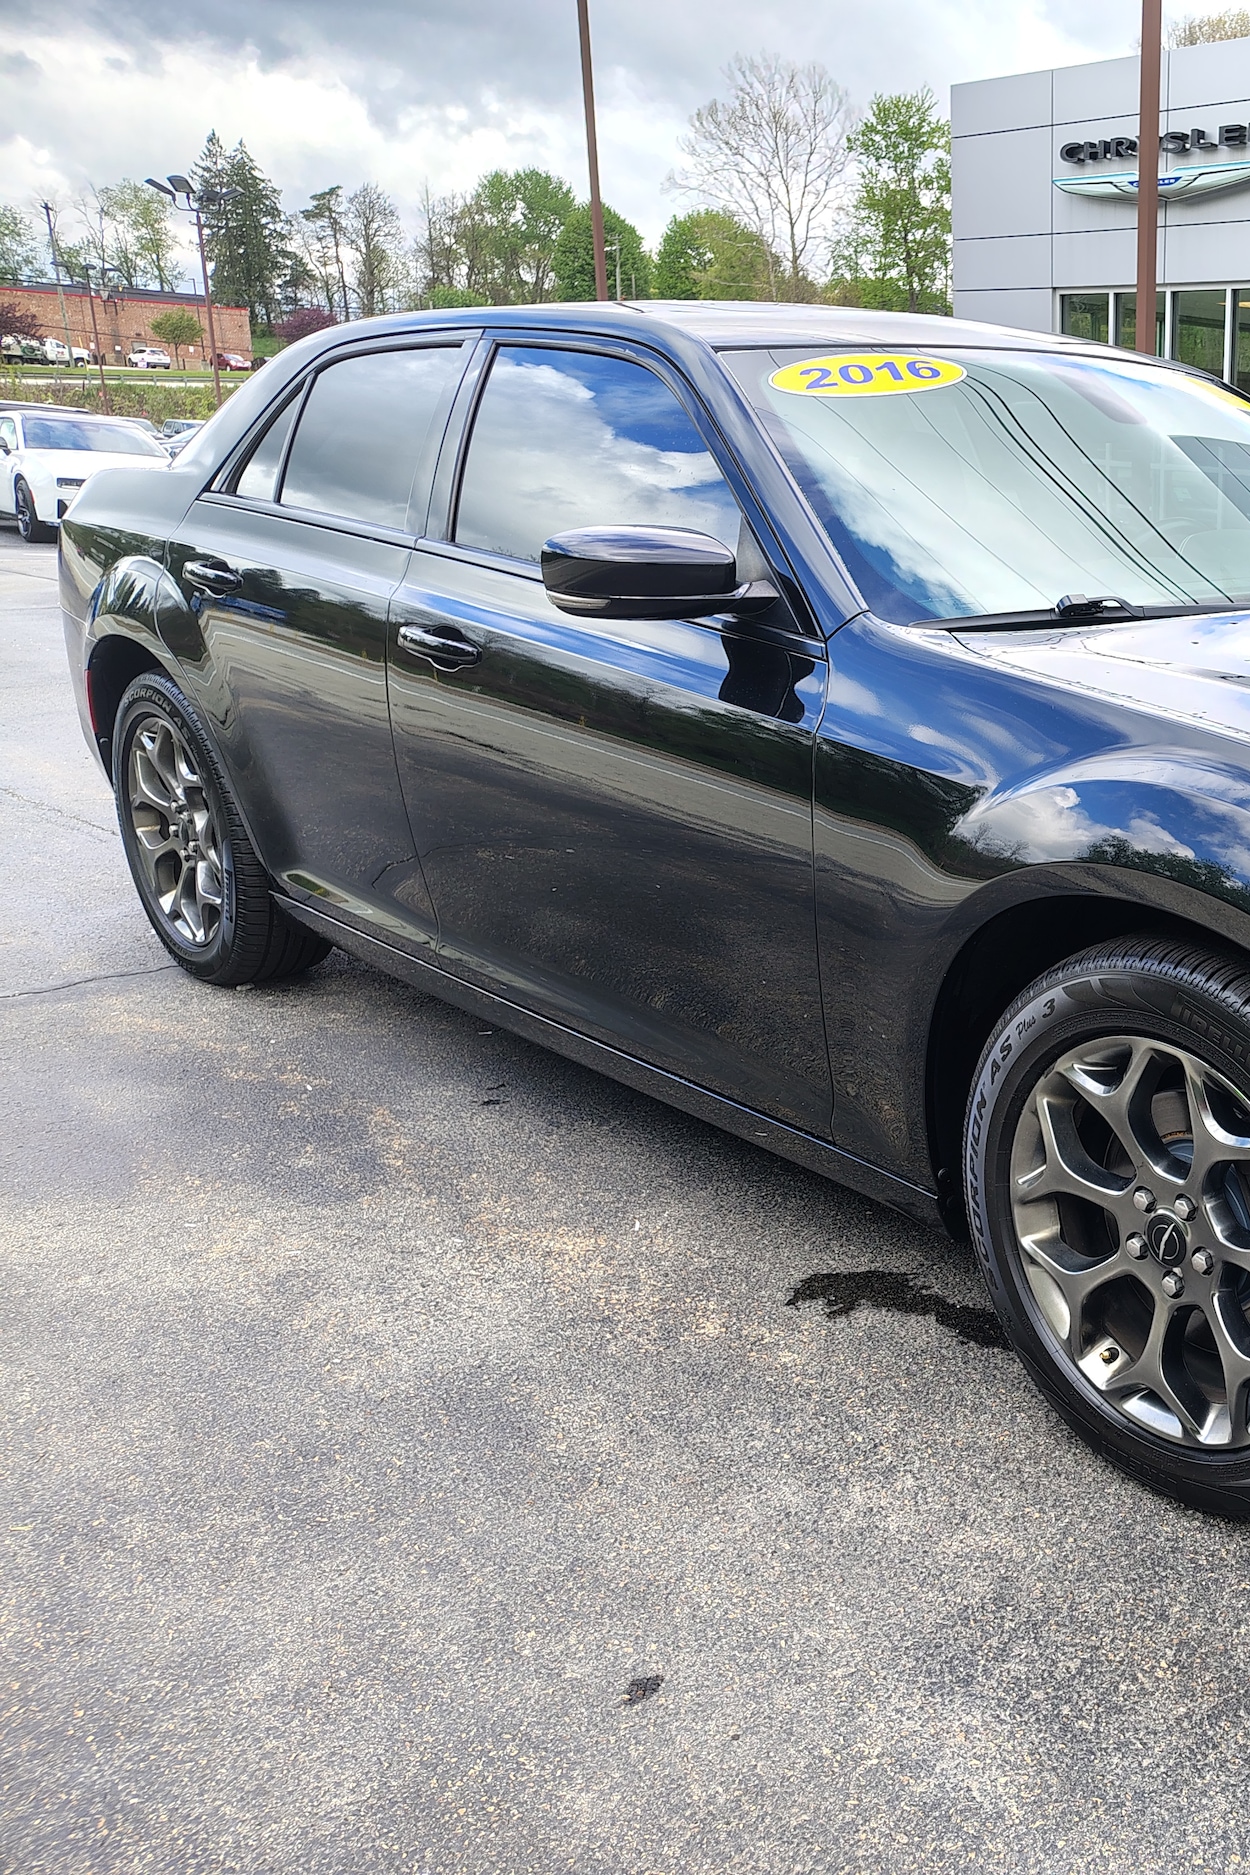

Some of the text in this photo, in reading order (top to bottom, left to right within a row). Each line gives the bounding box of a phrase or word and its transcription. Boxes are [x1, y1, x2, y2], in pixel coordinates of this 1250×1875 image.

[799, 360, 942, 390] 2016
[124, 687, 173, 713] SCORPION
[172, 716, 192, 740] AS
[966, 997, 1056, 1292] SCORPION AS Plus 3
